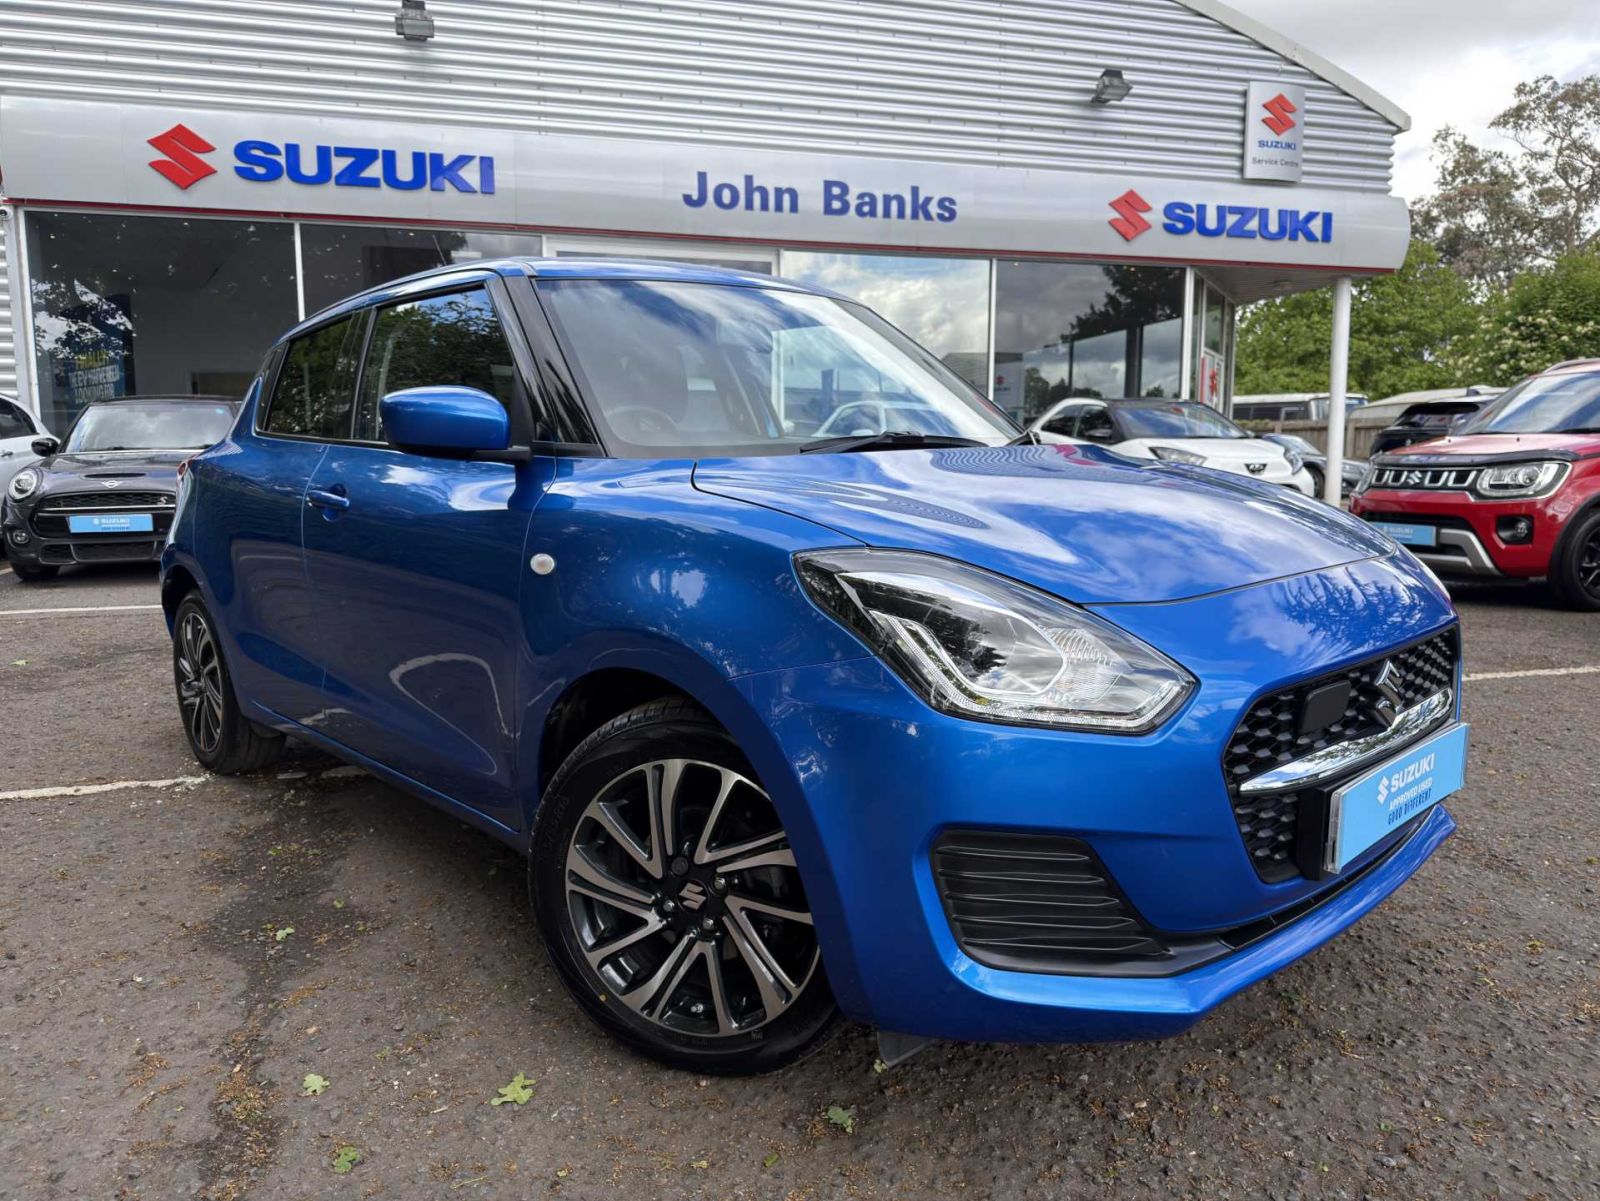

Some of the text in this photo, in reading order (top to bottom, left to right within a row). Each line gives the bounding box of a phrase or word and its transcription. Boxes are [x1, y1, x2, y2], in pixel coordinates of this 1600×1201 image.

[1252, 157, 1278, 166] Service
[1257, 139, 1297, 151] SUZUKI
[233, 140, 495, 195] SUZUKI
[682, 171, 957, 223] John Banks
[1163, 202, 1333, 243] SUZUKI
[1391, 752, 1435, 792] SUZUKI
